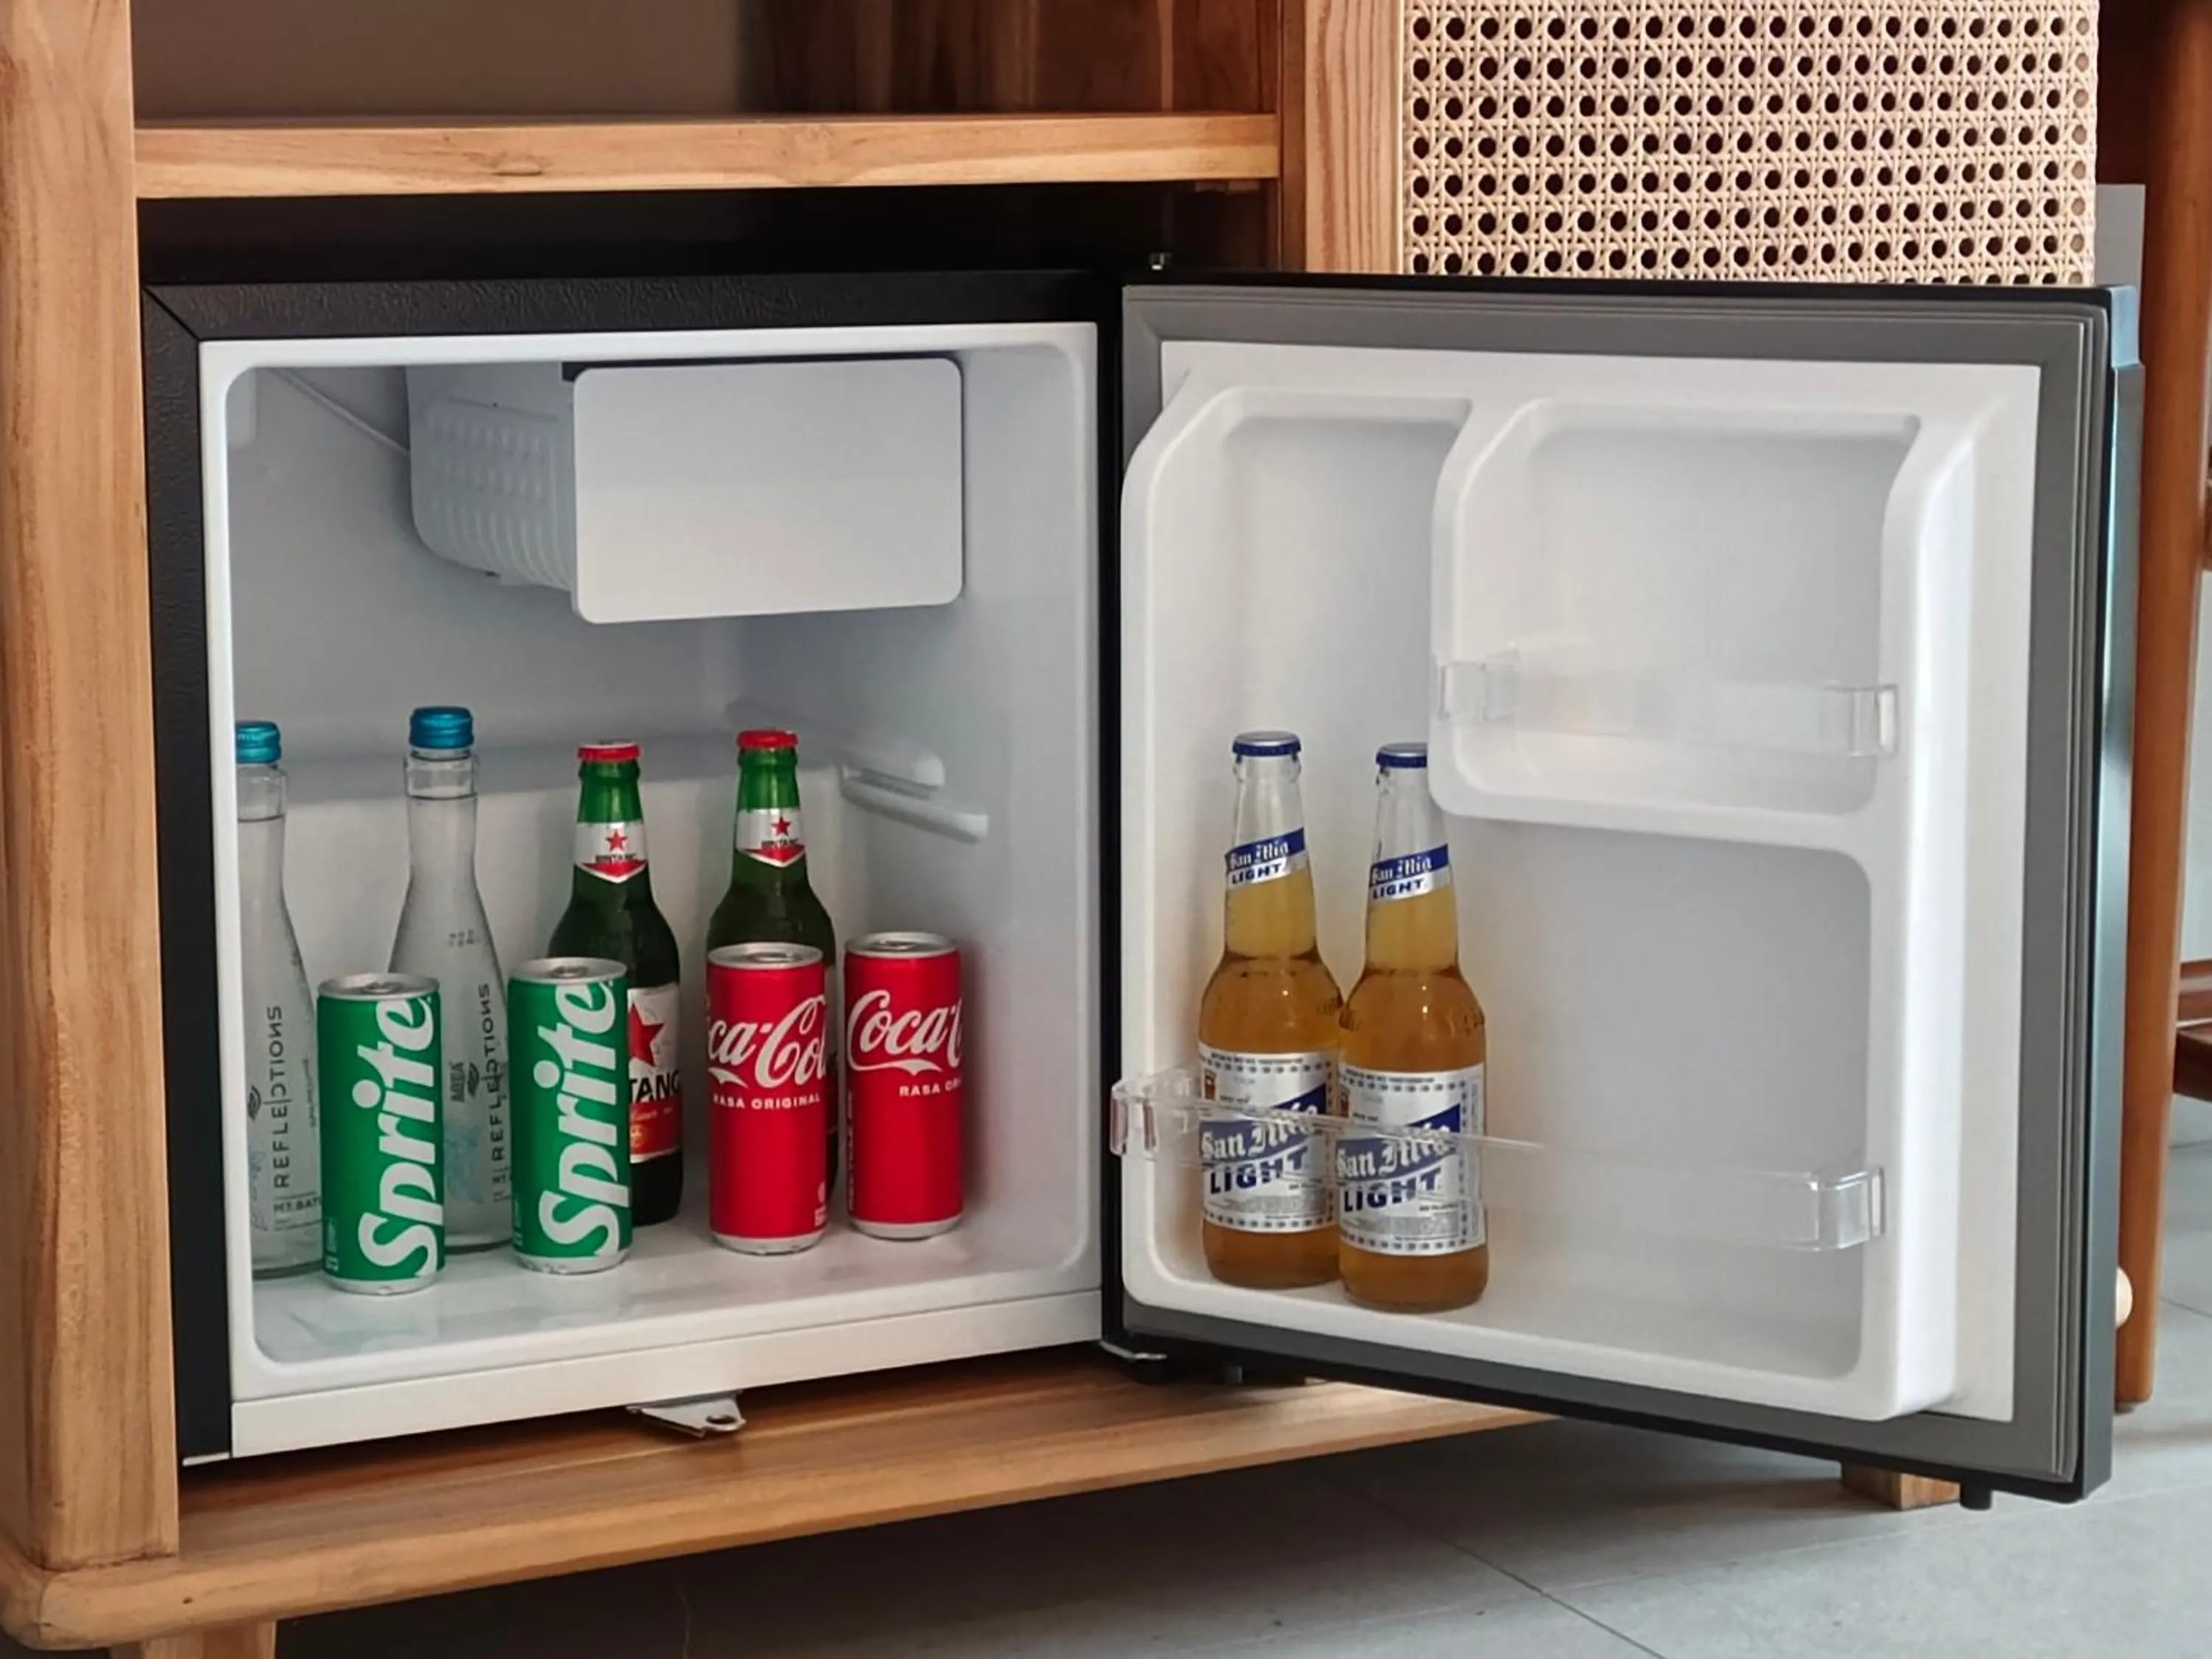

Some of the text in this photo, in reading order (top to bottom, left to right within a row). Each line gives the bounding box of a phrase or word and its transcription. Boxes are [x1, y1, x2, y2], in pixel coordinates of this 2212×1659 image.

[1231, 863, 1281, 885] LIGHT
[1372, 878, 1424, 900] LIGHT
[751, 1093, 821, 1110] ORIGINAL
[898, 1082, 940, 1098] RASA
[533, 981, 630, 1256] Sprite
[352, 997, 444, 1279] Sprite
[1200, 1130, 1246, 1161] San
[1210, 1146, 1309, 1195] LIGHT
[1336, 1147, 1377, 1179] San
[1344, 1166, 1441, 1213] LIGHT
